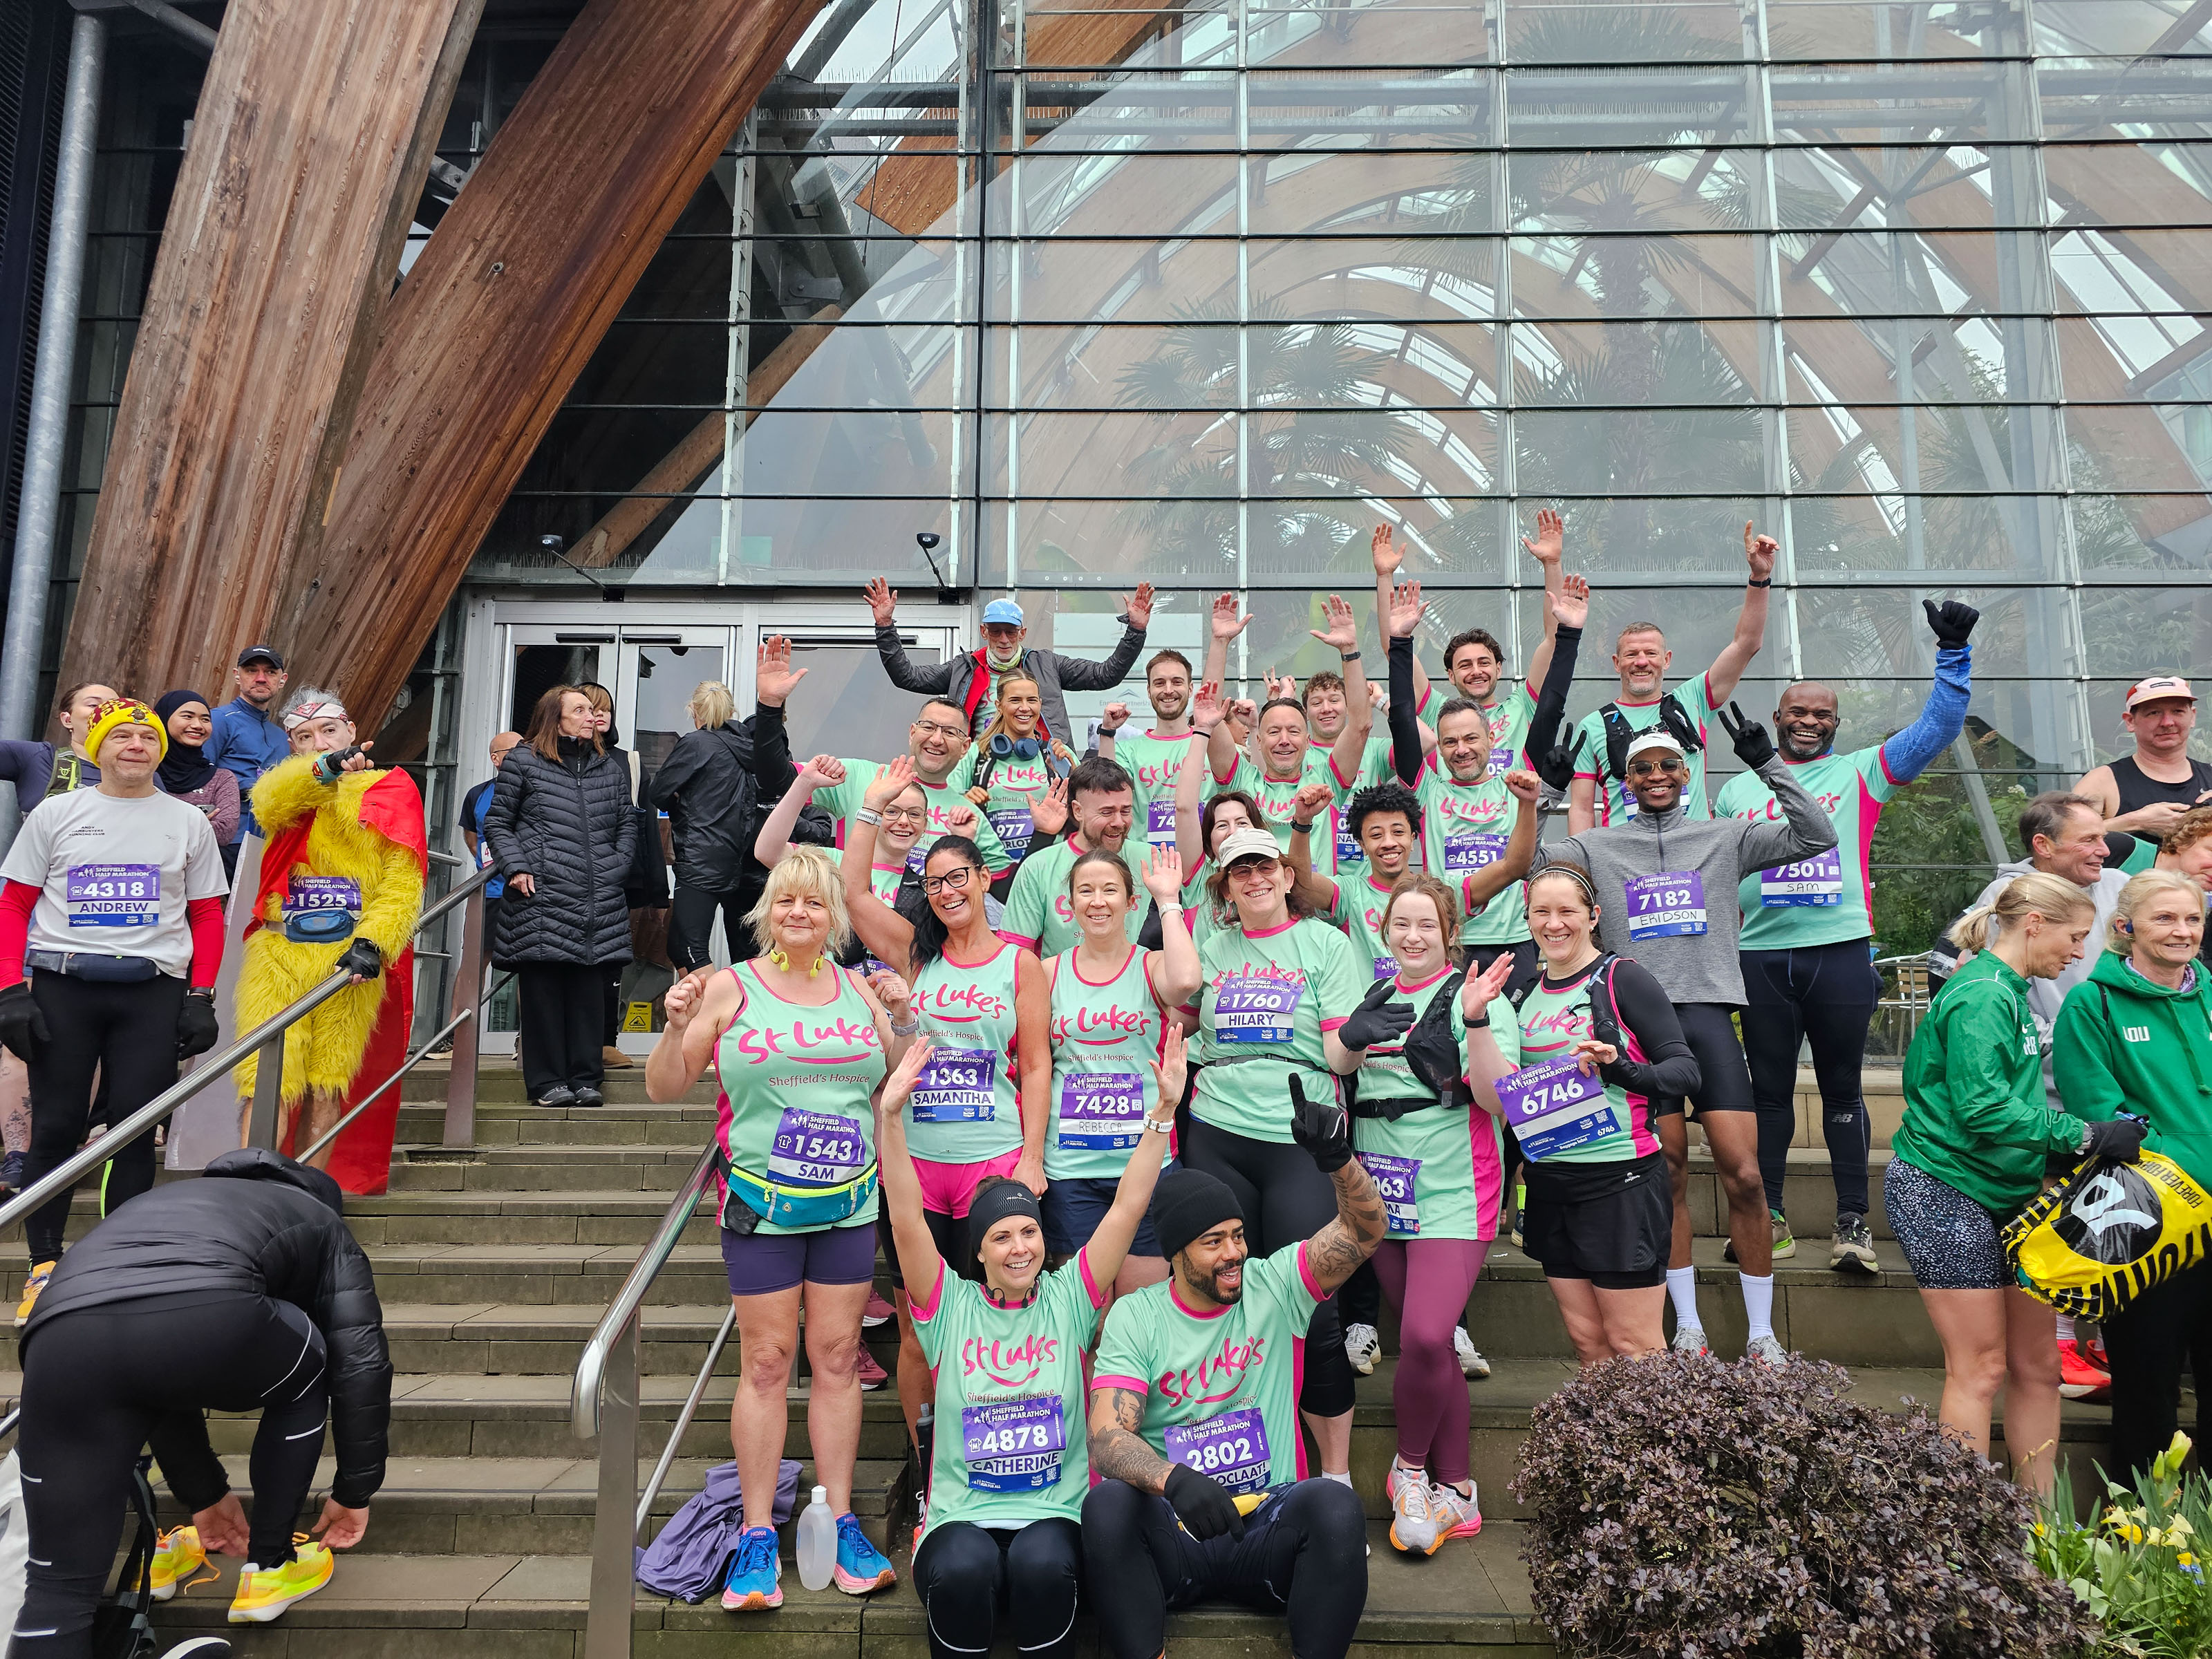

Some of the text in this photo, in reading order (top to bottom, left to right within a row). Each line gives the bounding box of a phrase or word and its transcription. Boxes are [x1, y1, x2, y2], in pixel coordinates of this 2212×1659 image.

[1007, 765, 1047, 784] Luke
[1138, 765, 1161, 788] St
[1487, 762, 1505, 776] 05
[1440, 796, 1459, 820] St
[1157, 815, 1175, 828] 74
[1456, 850, 1497, 865] 4551
[1775, 862, 1826, 879] 7501
[83, 881, 144, 897] 4318
[1659, 879, 1691, 887] MARATHON
[1787, 883, 1819, 892] SAM
[79, 902, 149, 912] ANDREW
[298, 893, 347, 907] 1525
[1638, 889, 1692, 911] 7182
[1640, 910, 1697, 926] ERIDSON
[1257, 984, 1291, 993] MARATHON
[936, 983, 1007, 1020] Luke's
[1232, 993, 1282, 1009] 1760
[1051, 1004, 1151, 1047] St Luke's
[1228, 1014, 1275, 1026] HILARY
[956, 1031, 984, 1041] Hospice
[738, 1029, 788, 1065] St
[1067, 1053, 1134, 1062] Sheffield's Hospice
[769, 1074, 870, 1087] Sheffield's Hospice
[929, 1067, 977, 1086] 1363
[1521, 1065, 1551, 1080] SHEFFIELD
[1524, 1062, 1578, 1087] HALF MARATHON
[914, 1092, 991, 1105] SAMANTHA
[1521, 1077, 1584, 1115] 6746
[1074, 1095, 1130, 1115] 7428
[809, 1116, 840, 1125] SHEFFIELD
[1078, 1121, 1123, 1133] REBECCA
[825, 1125, 856, 1134] MARATHON
[1597, 1125, 1615, 1136] 6746
[794, 1134, 852, 1161] 1543
[1367, 1156, 1391, 1164] SHEFFIELD
[1379, 1163, 1411, 1173] MARATHON
[798, 1164, 834, 1180] SAM
[2160, 1172, 2204, 1209] FOREVER
[962, 1336, 989, 1376] St
[1159, 1335, 1265, 1407] St Luke's
[968, 1389, 1055, 1404] Sheffield's Hospice
[992, 1405, 1024, 1414] SHEFFIELD
[1010, 1409, 1051, 1420] MARATHON
[1192, 1420, 1224, 1432] SHEFFIELD
[1194, 1421, 1250, 1440] HALF MARATHON
[982, 1425, 1049, 1452] 4878
[972, 1452, 1059, 1473] CATHERINE
[1187, 1438, 1253, 1472] 2802
[1212, 1461, 1266, 1485] OCLAAT!
